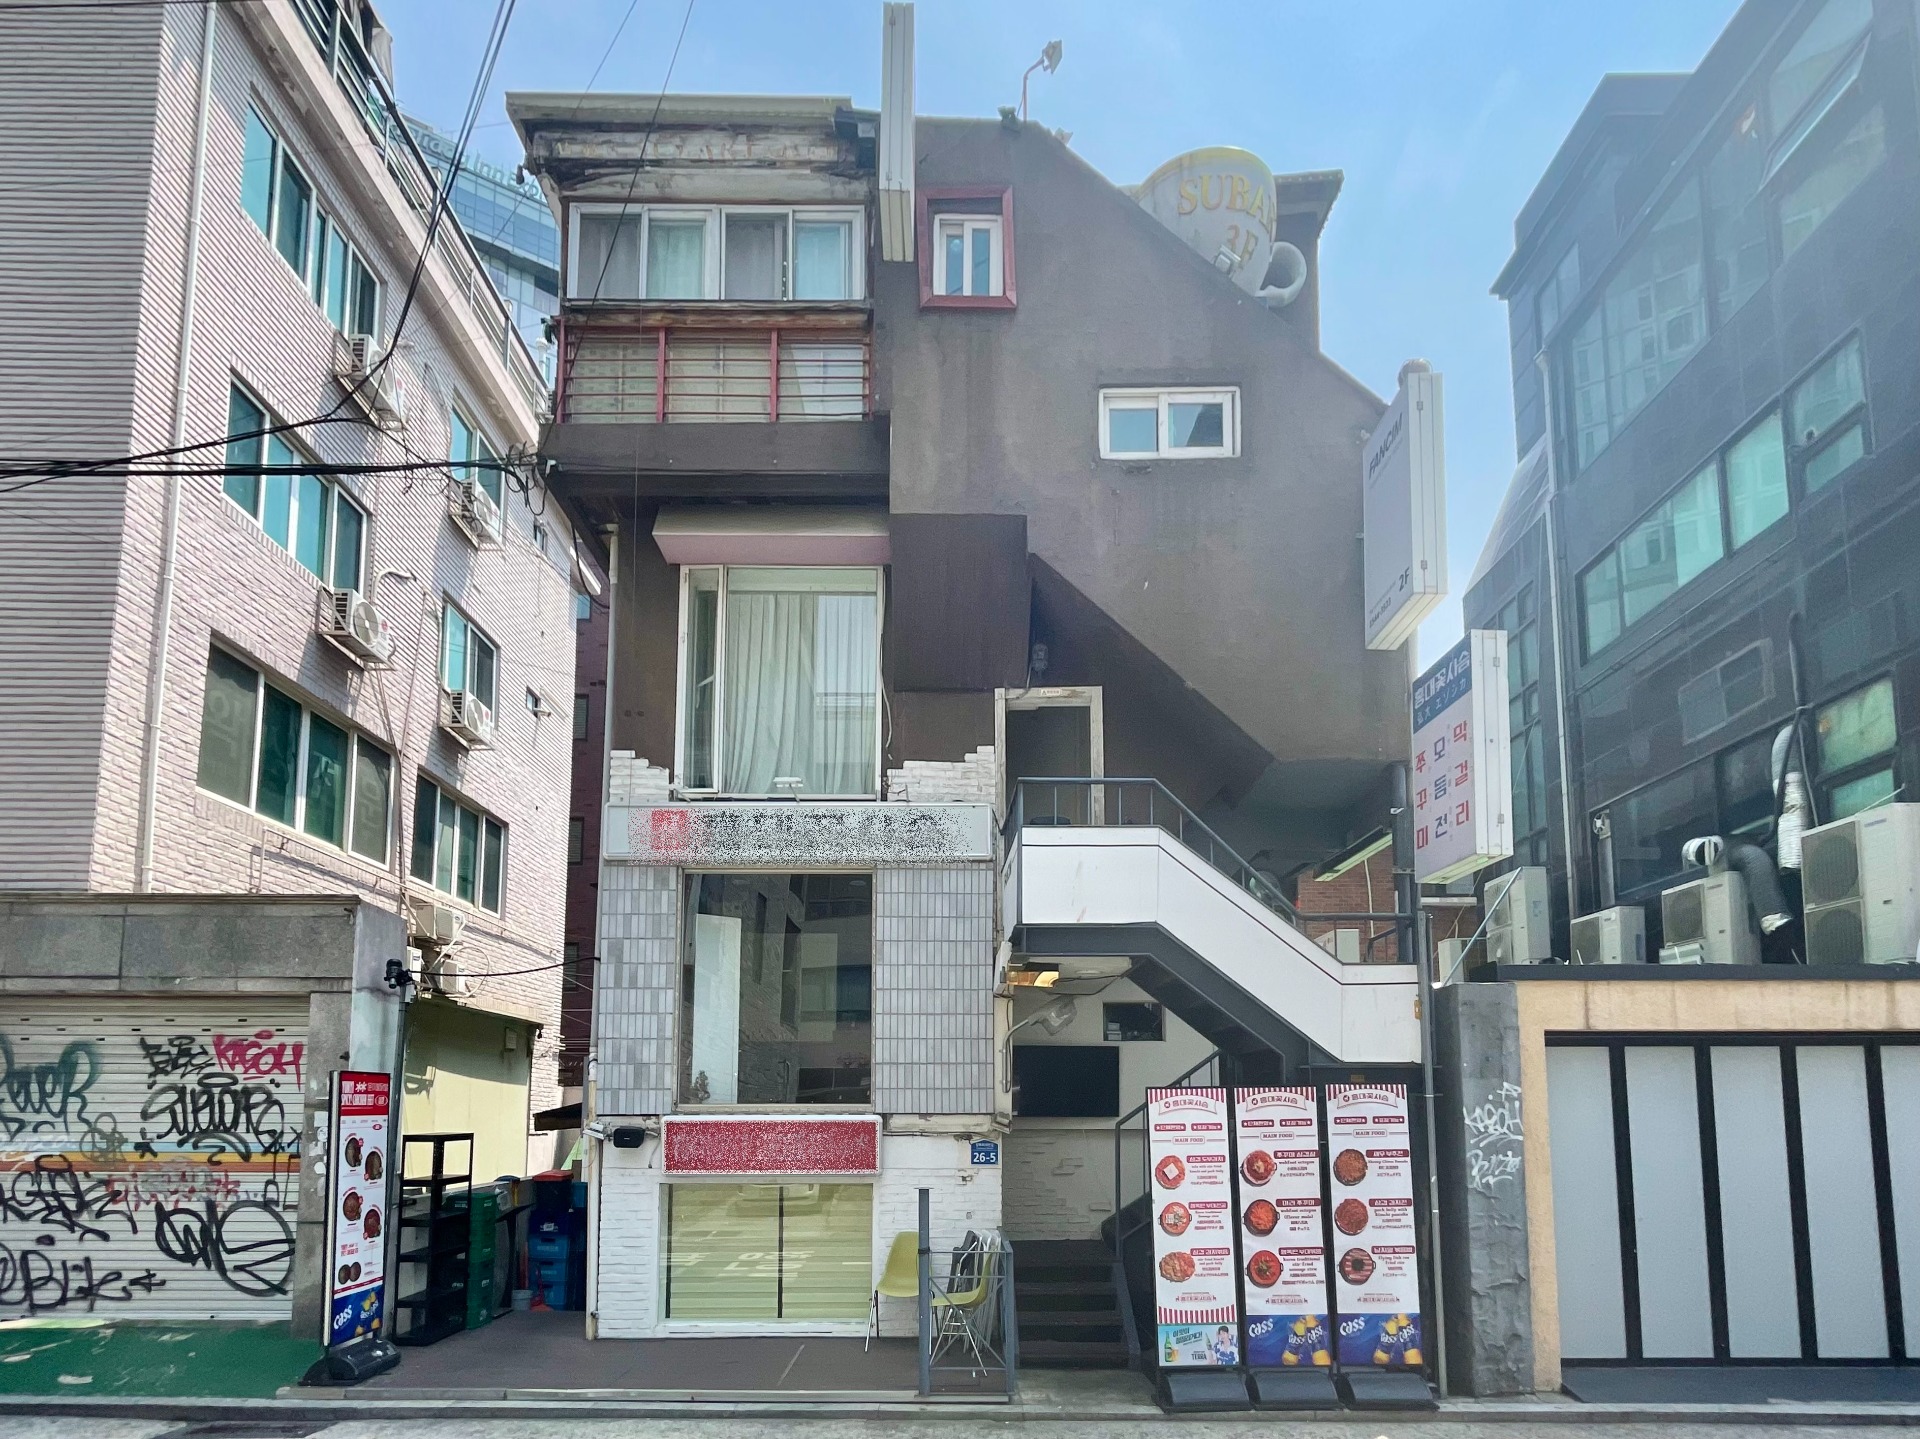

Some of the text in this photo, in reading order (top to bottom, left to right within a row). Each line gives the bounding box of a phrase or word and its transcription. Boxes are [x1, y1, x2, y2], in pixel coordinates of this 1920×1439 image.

[1399, 567, 1410, 592] 2F
[1415, 650, 1470, 709] 홍대꽃사슴
[1415, 750, 1428, 849] 쭈꾸미
[1434, 736, 1448, 838] 모듬전
[1453, 720, 1469, 826] 막걸리
[973, 1153, 996, 1162] 26-5
